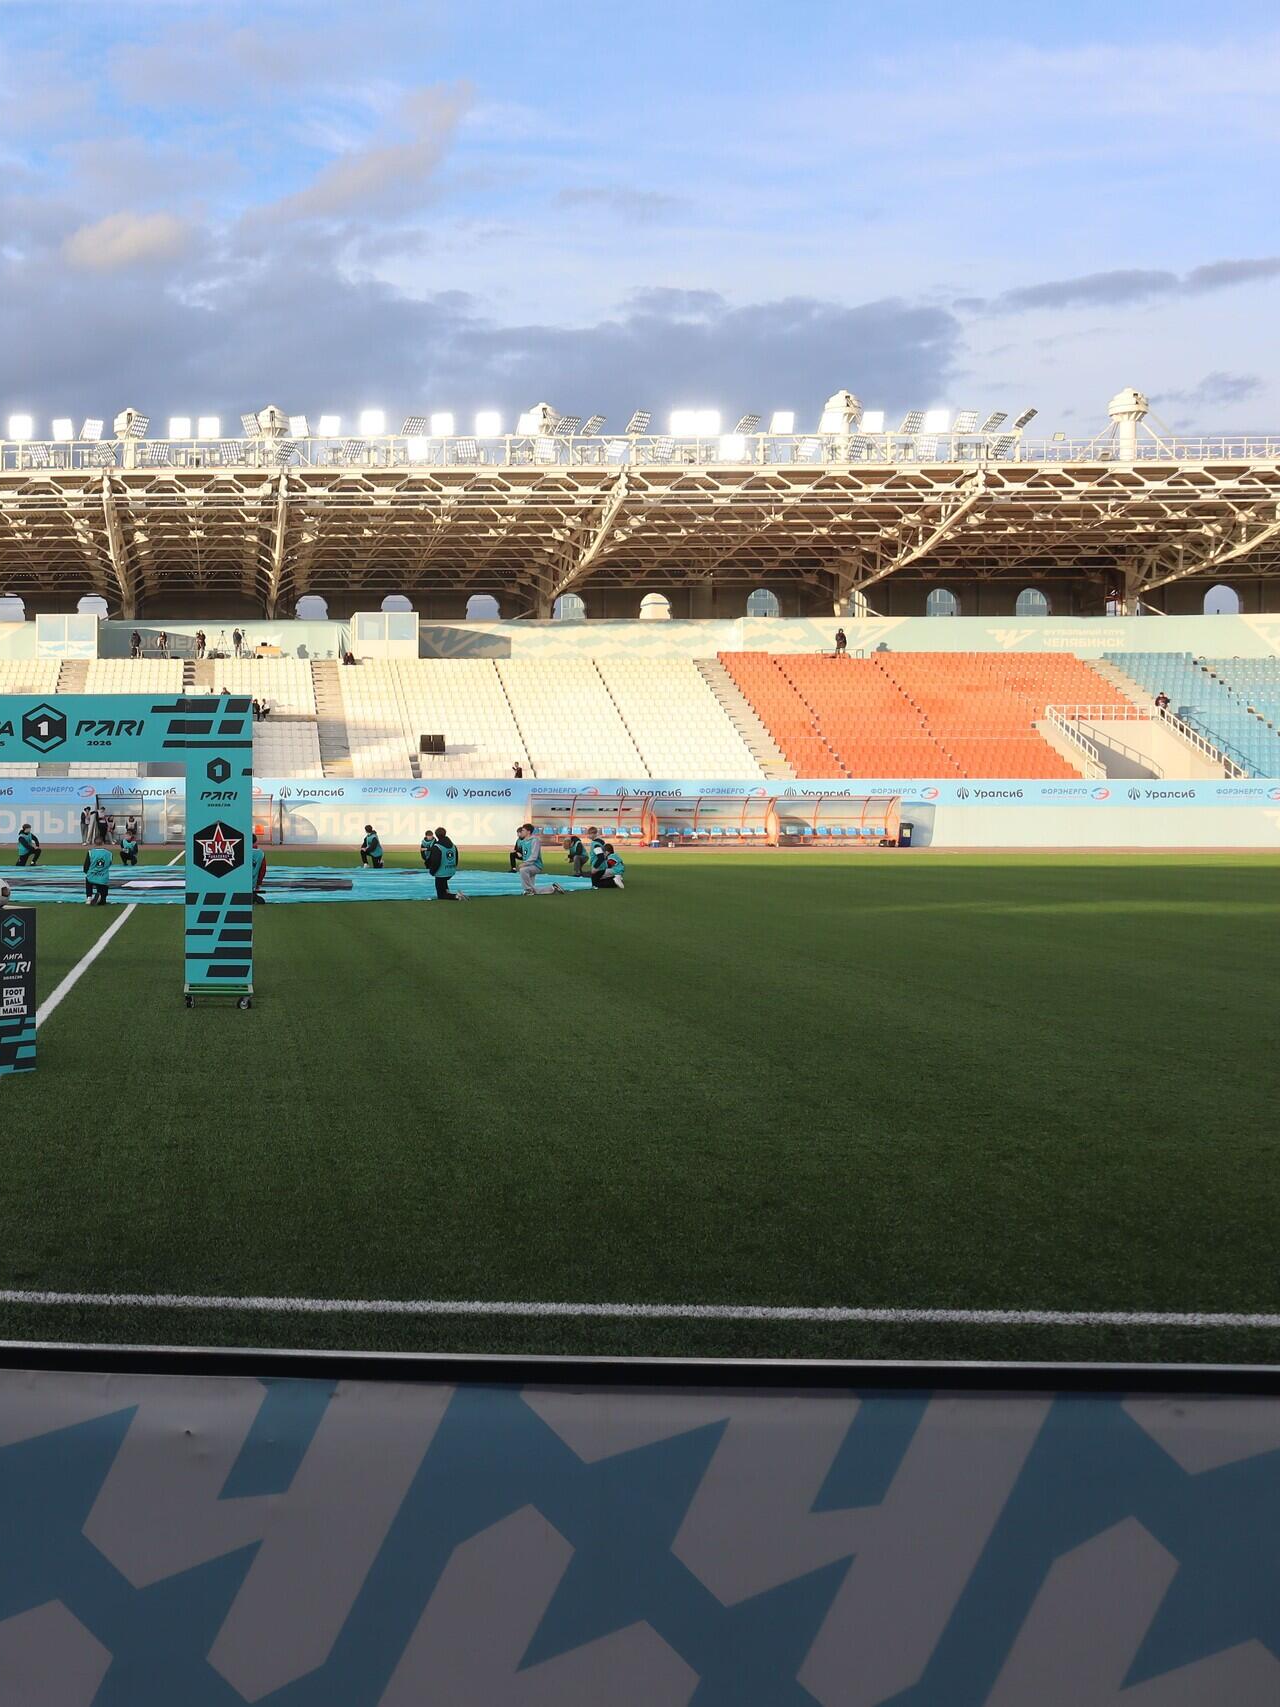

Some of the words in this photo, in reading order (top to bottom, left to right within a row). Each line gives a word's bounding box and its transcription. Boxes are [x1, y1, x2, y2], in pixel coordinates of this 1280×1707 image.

[37, 721, 49, 736] 1
[75, 719, 144, 736] PARI
[213, 764, 223, 777] 1
[128, 787, 177, 796] Уралсиб
[200, 791, 238, 800] PARI
[296, 787, 345, 797] Уралсиб
[463, 787, 512, 798] Уралсиб
[973, 789, 1023, 799] Уралсиб
[1145, 789, 1195, 799] Уралсиб
[205, 841, 232, 854] СКА
[9, 926, 16, 937] 1
[3, 953, 23, 961] ЛИГА
[5, 988, 22, 996] FOOT
[6, 997, 22, 1006] BALL
[2, 1007, 25, 1015] MANIA
